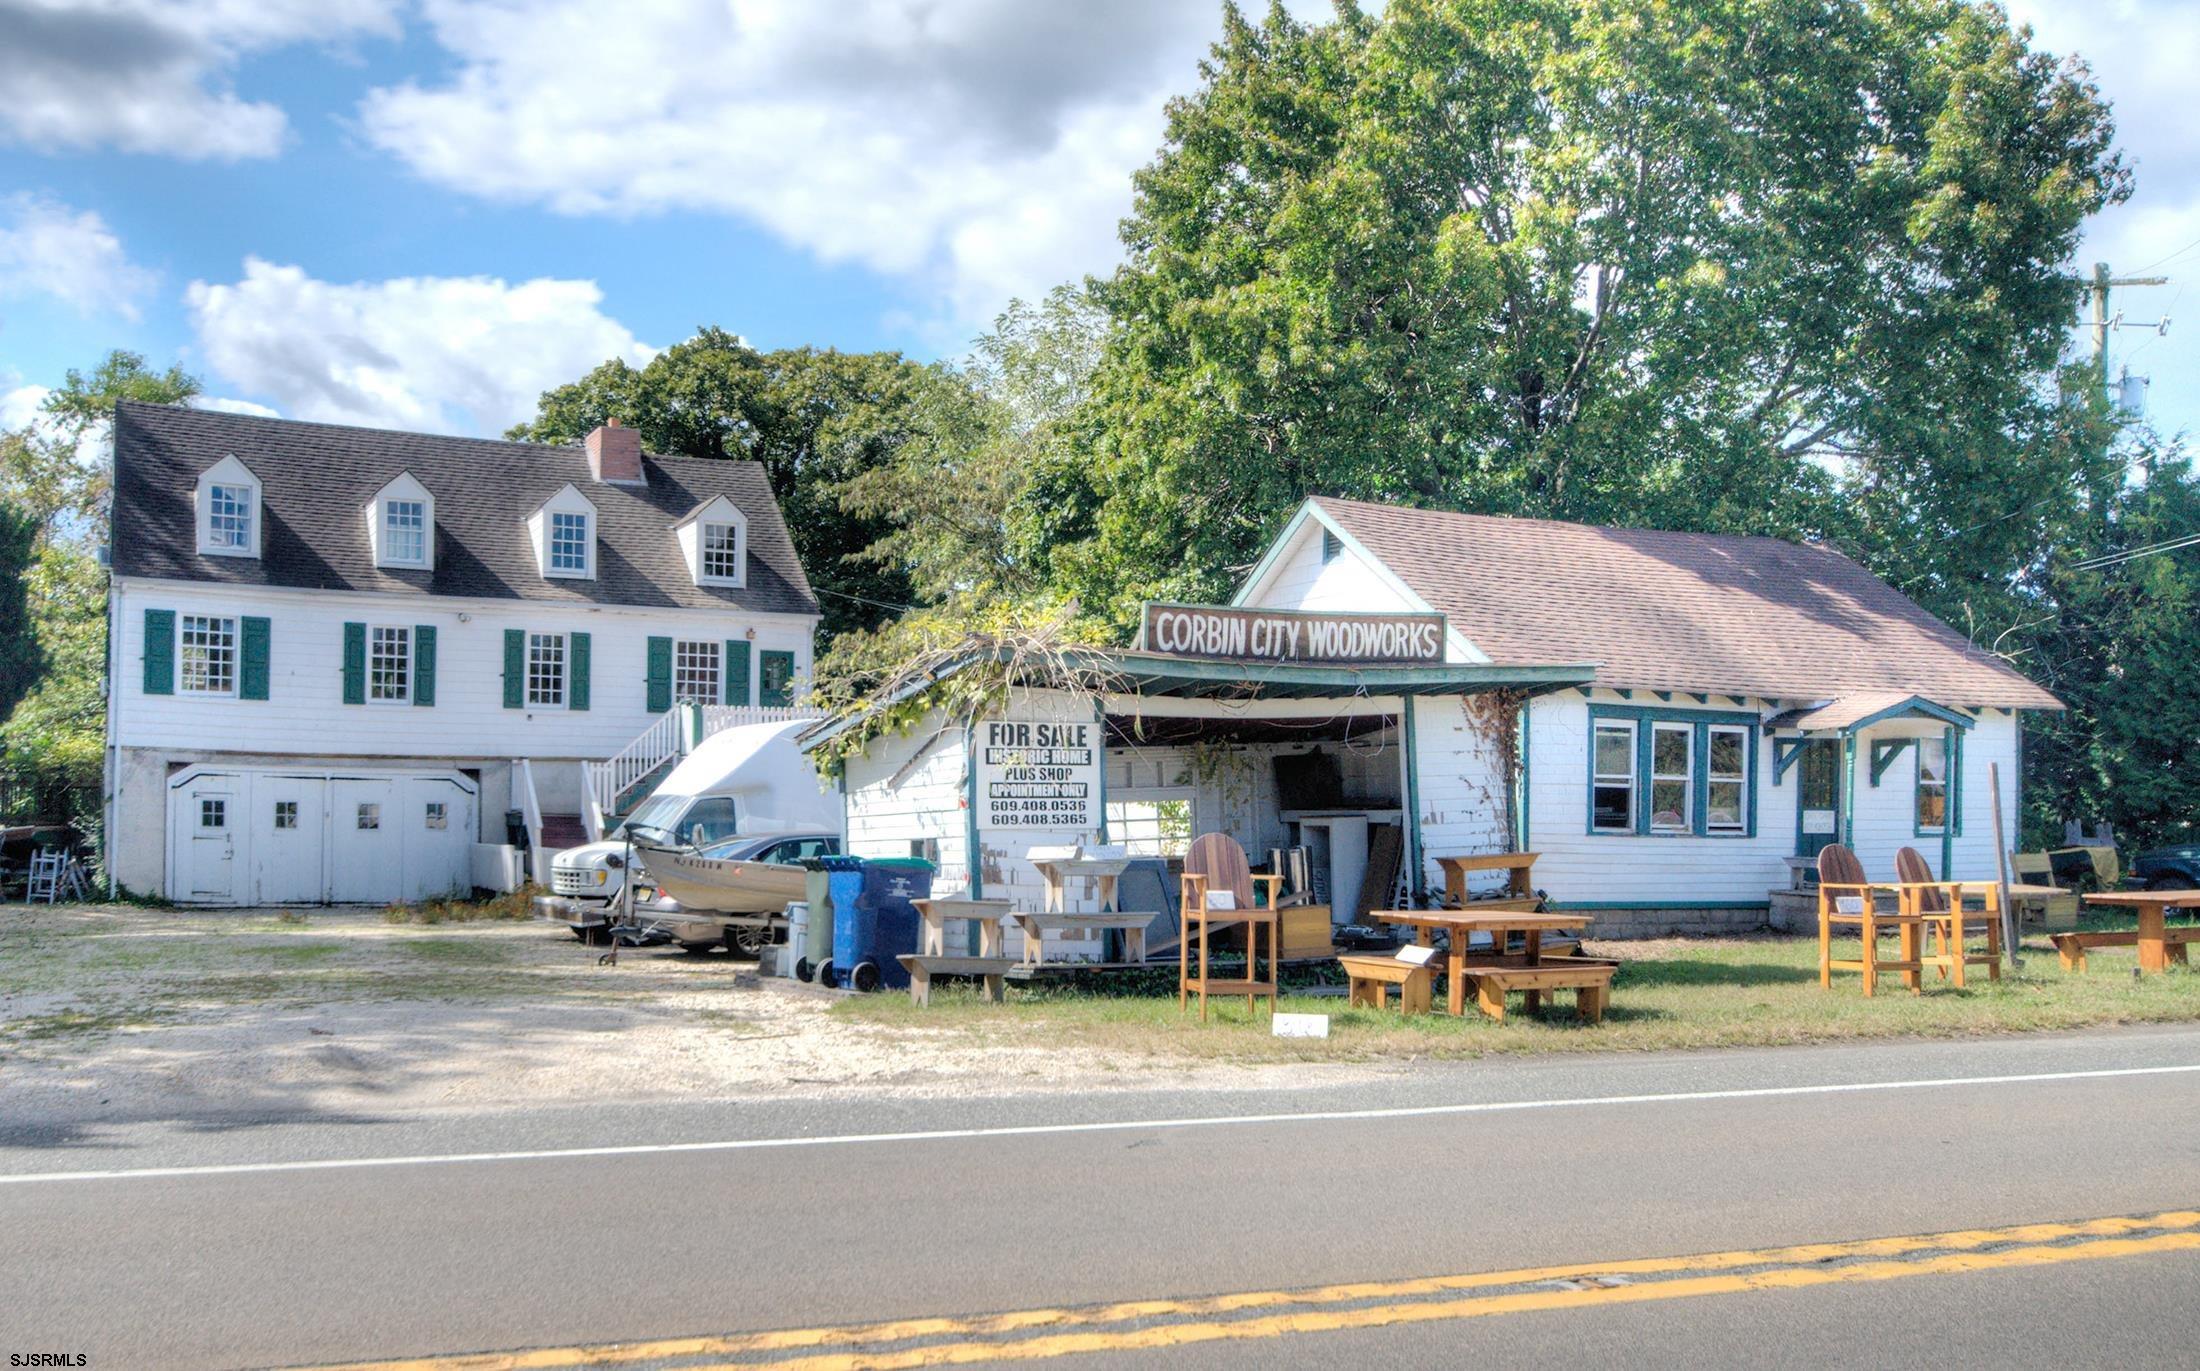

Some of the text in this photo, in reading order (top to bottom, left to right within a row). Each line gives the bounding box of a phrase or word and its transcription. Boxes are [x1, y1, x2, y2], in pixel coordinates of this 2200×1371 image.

[1156, 612, 1439, 658] CORBIN CITY WOODWORKS
[989, 723, 1088, 748] FOR SALE
[988, 748, 1089, 765] HISRIC HOME
[1005, 767, 1073, 781] PLUS SHOP
[990, 782, 1086, 798] APPOINTMENT ONLY
[990, 799, 1087, 812] 609.408.0536
[991, 813, 1088, 826] 609.408.5365
